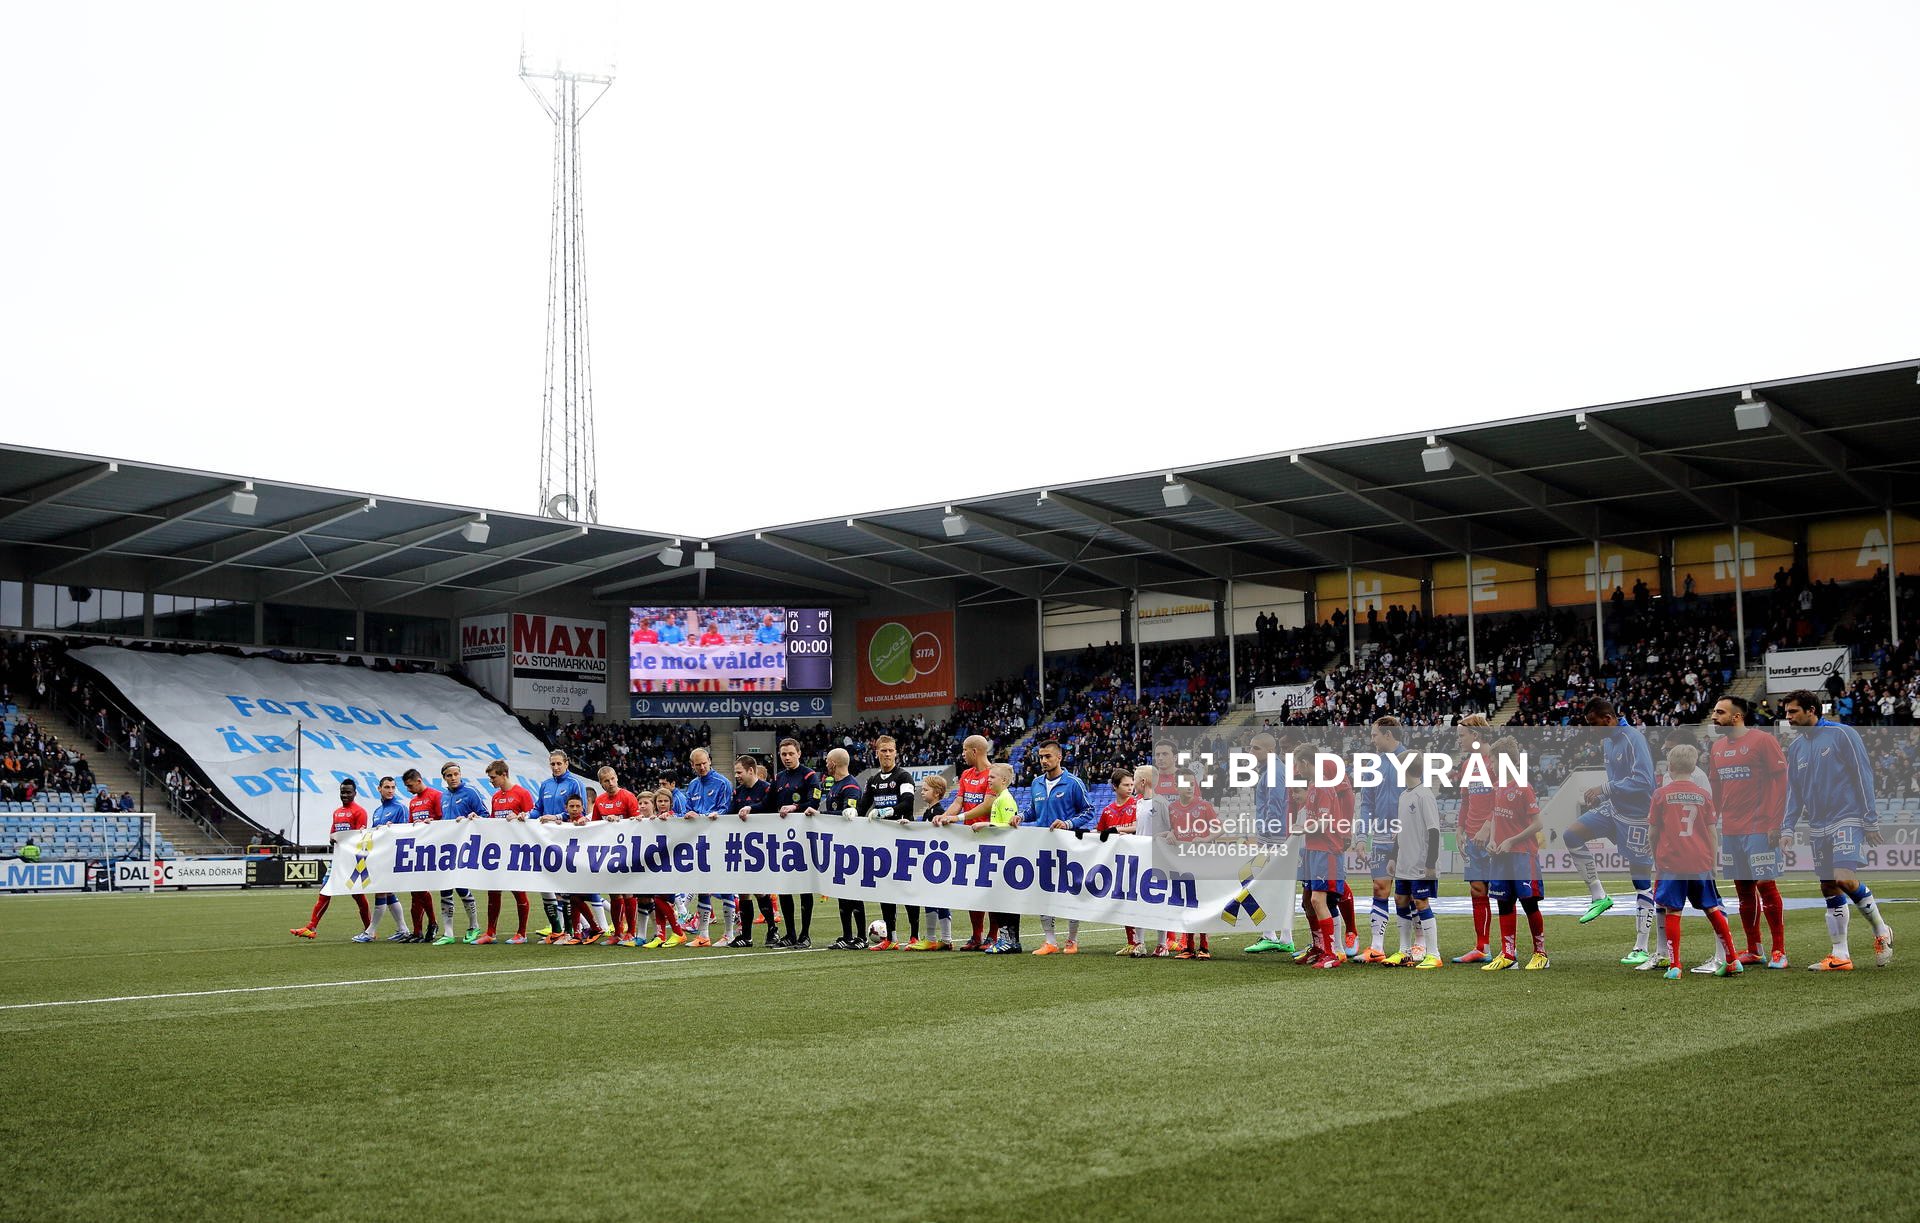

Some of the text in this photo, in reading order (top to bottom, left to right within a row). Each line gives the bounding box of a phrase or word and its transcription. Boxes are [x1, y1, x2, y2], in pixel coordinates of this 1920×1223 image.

[1171, 602, 1211, 615] HEMMA
[790, 619, 799, 633] 0
[818, 619, 828, 633] 0
[462, 625, 506, 648] MAXI
[513, 613, 606, 659] MAXI
[790, 640, 828, 653] 00:00
[915, 648, 935, 659] SITA
[513, 654, 529, 666] ICA
[531, 655, 606, 672] STORMARKNAD
[661, 653, 707, 670] mot
[713, 650, 784, 670] våldet
[1768, 665, 1821, 676] lundgrens
[532, 682, 589, 696] Öppet alla dagar
[864, 695, 874, 703] DIN
[894, 690, 948, 701] SAMARBETSPARTNER
[551, 697, 570, 706] 07-22
[662, 697, 800, 716] www.edbygg.se
[225, 695, 440, 732] FOTBOLL
[216, 725, 297, 754] ÄR
[299, 728, 423, 760] VÅRT
[430, 741, 507, 761] LIV
[232, 766, 324, 798] DET
[1678, 804, 1699, 837] 3
[120, 865, 174, 881] DALOC
[177, 865, 207, 878] SÄKRA
[208, 864, 244, 878] DÖRRAR
[393, 828, 1199, 908] Enade mot våldet #StåUppFörFotbollen
